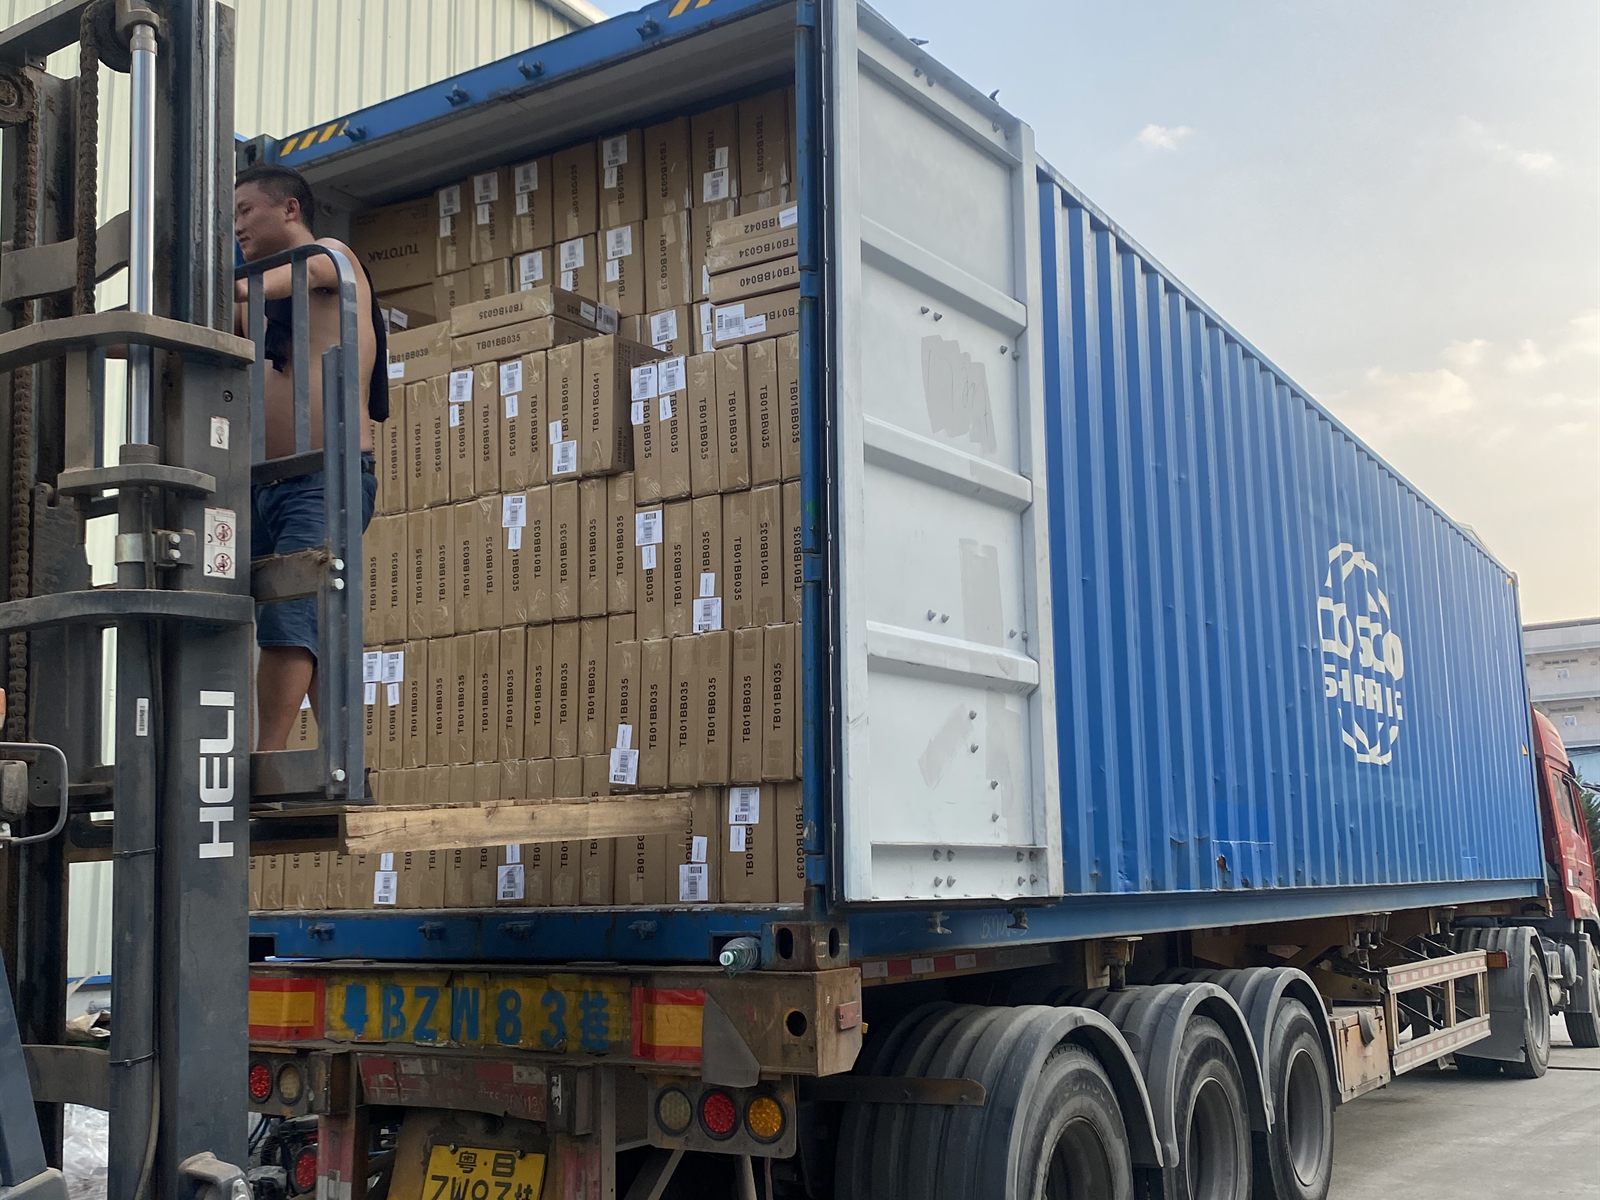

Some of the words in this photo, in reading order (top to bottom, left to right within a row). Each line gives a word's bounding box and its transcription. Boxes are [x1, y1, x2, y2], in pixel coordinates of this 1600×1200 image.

[708, 129, 716, 171] TB01BG
[617, 165, 625, 205] TB01BG
[368, 242, 419, 262] TUTOTAK
[739, 237, 796, 259] TB01BG034
[744, 214, 780, 234] 1BB042
[740, 266, 796, 288] TB01BB040
[476, 333, 521, 349] TB01BB035
[478, 303, 523, 320] TB01BG035
[482, 403, 490, 462] TB01BB035
[530, 393, 538, 453] TB01BB035
[592, 372, 600, 432] TB01BG041
[643, 398, 652, 459] TB01BB035
[670, 392, 678, 453] TB01BB035
[699, 397, 708, 460] TB01BB035
[728, 391, 737, 453] TB01BB035
[760, 385, 769, 448] TB01BB035
[790, 379, 800, 444] TB01BB035
[434, 415, 442, 473] TB01BB035
[509, 417, 517, 457] 1BB035
[512, 549, 520, 592] 1BB035
[589, 518, 597, 579] TB01BB035
[616, 515, 624, 576] TB01BB035
[674, 544, 682, 607] TB01BB035
[733, 536, 742, 601] TB01BB035
[760, 522, 769, 587] TB01BB035
[793, 526, 802, 591] TB01BB035
[391, 552, 399, 608] TB01BB035
[646, 569, 654, 603] BB035
[366, 705, 374, 736] BB035
[410, 680, 418, 738] TB01BB035
[481, 672, 489, 733] TB01BB035
[506, 669, 514, 730] TB01BB035
[534, 665, 542, 726] TB01BB035
[559, 662, 568, 724] TB01BB035
[587, 660, 596, 722] TB01BB035
[620, 678, 629, 725] 1BB035
[649, 684, 658, 750] TB01BB035
[679, 681, 688, 748] TB01BB035
[707, 677, 717, 744] TB01BB035
[742, 675, 752, 743] TB01BB035
[773, 662, 782, 731] TB01BB035
[389, 705, 397, 742] 1BB035
[199, 691, 235, 858] HELI
[636, 835, 645, 882] TB01BG
[746, 824, 755, 877] TB01BG
